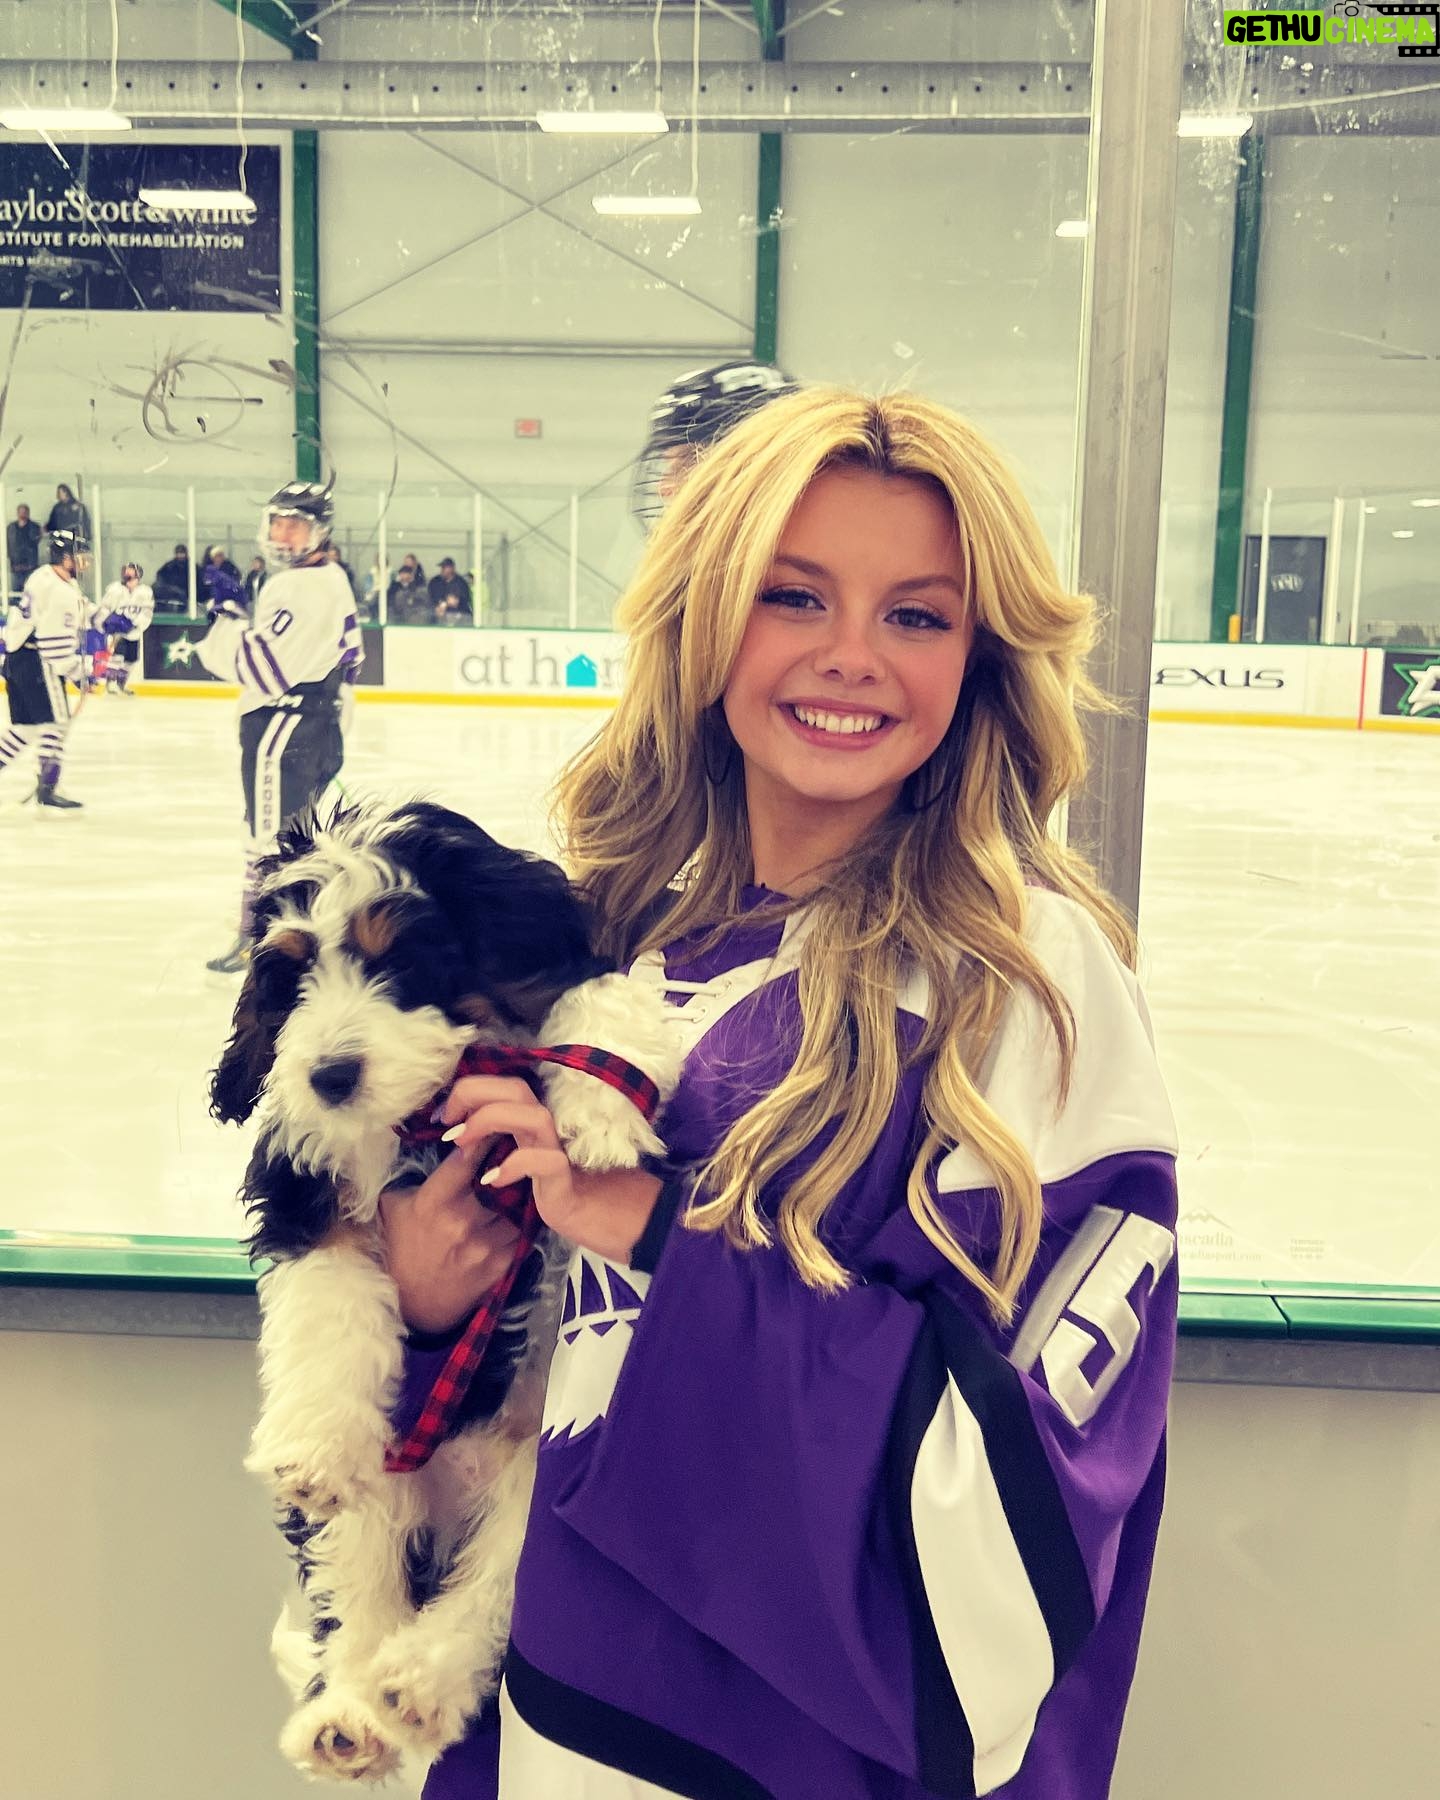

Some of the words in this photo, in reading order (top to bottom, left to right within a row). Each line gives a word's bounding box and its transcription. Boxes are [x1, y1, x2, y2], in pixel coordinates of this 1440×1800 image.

[68, 232, 103, 247] FOR
[107, 232, 245, 249] REHABILITATION
[460, 645, 512, 686] at
[1155, 667, 1284, 689] EXUS
